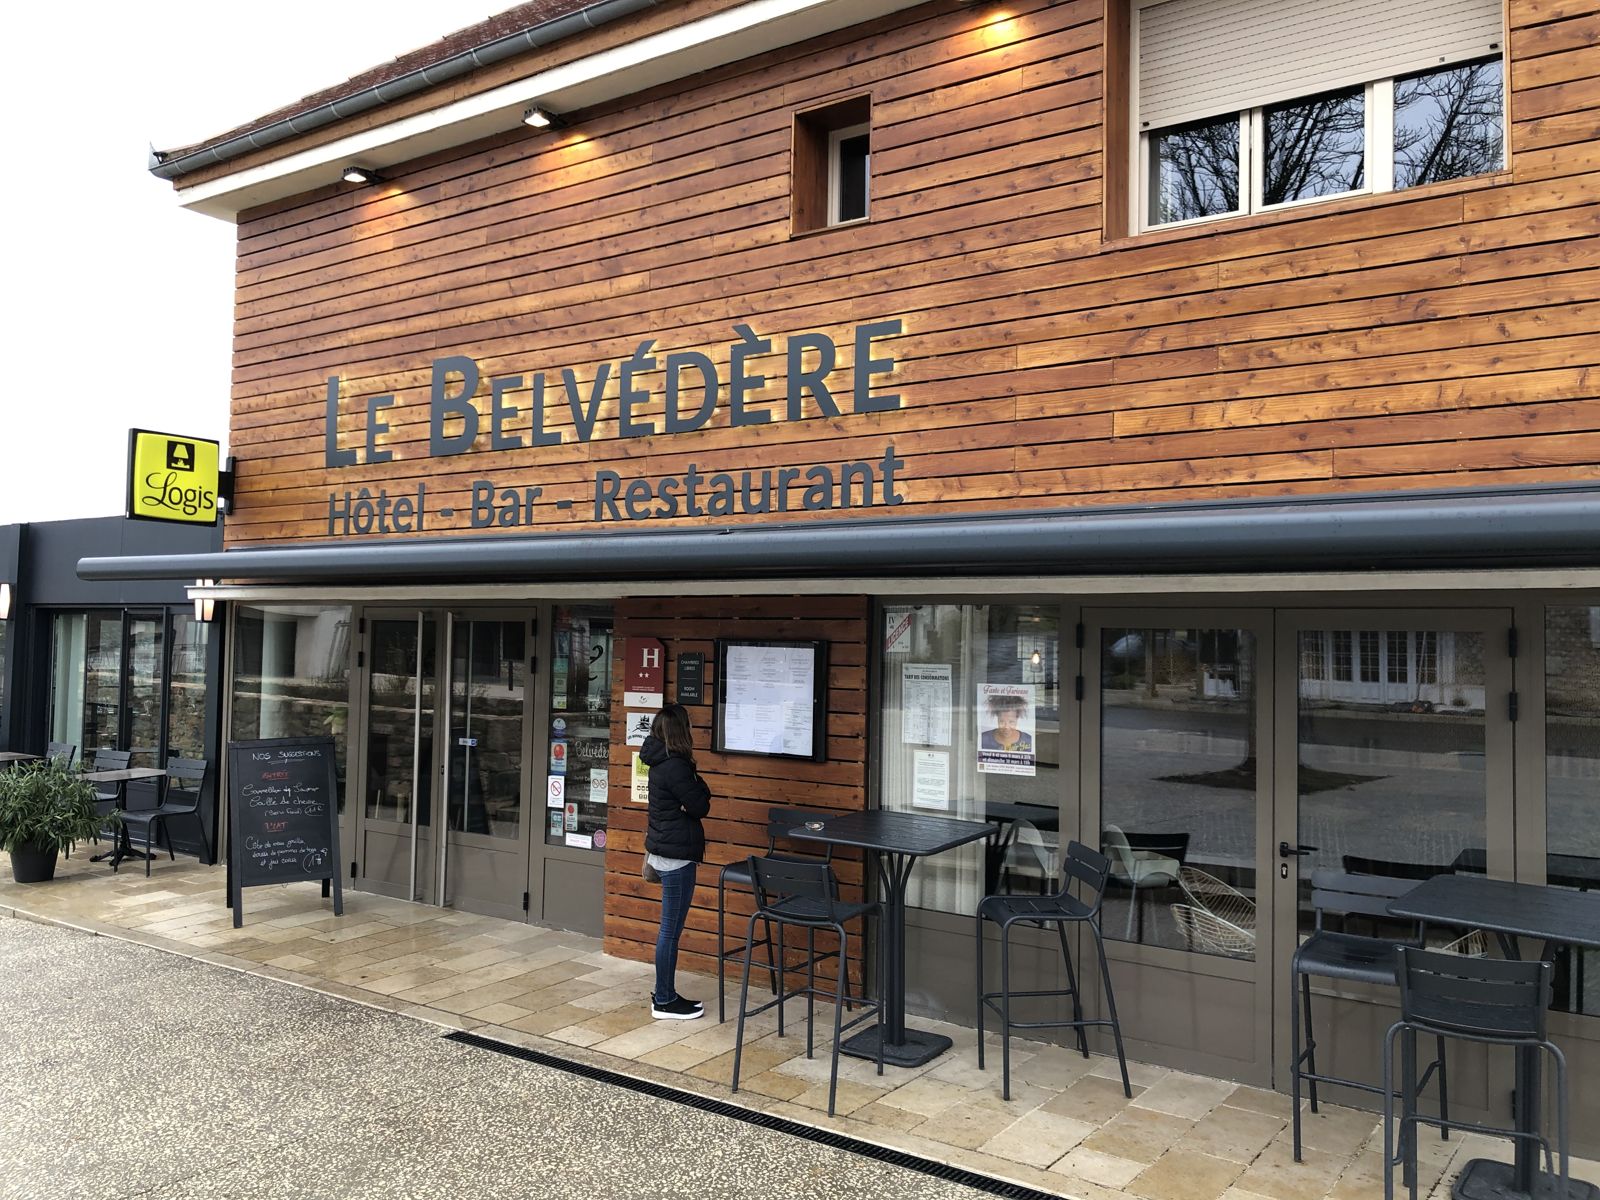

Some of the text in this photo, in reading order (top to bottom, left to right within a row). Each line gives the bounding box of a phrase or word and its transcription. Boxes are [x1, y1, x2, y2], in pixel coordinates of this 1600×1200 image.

[430, 319, 903, 457] BELVÉDÈRE
[142, 471, 214, 515] Logis
[327, 483, 425, 537] Hôtel
[470, 480, 543, 528] Bar
[594, 446, 904, 522] Restaurant
[642, 648, 660, 668] H
[252, 752, 271, 760] NOS
